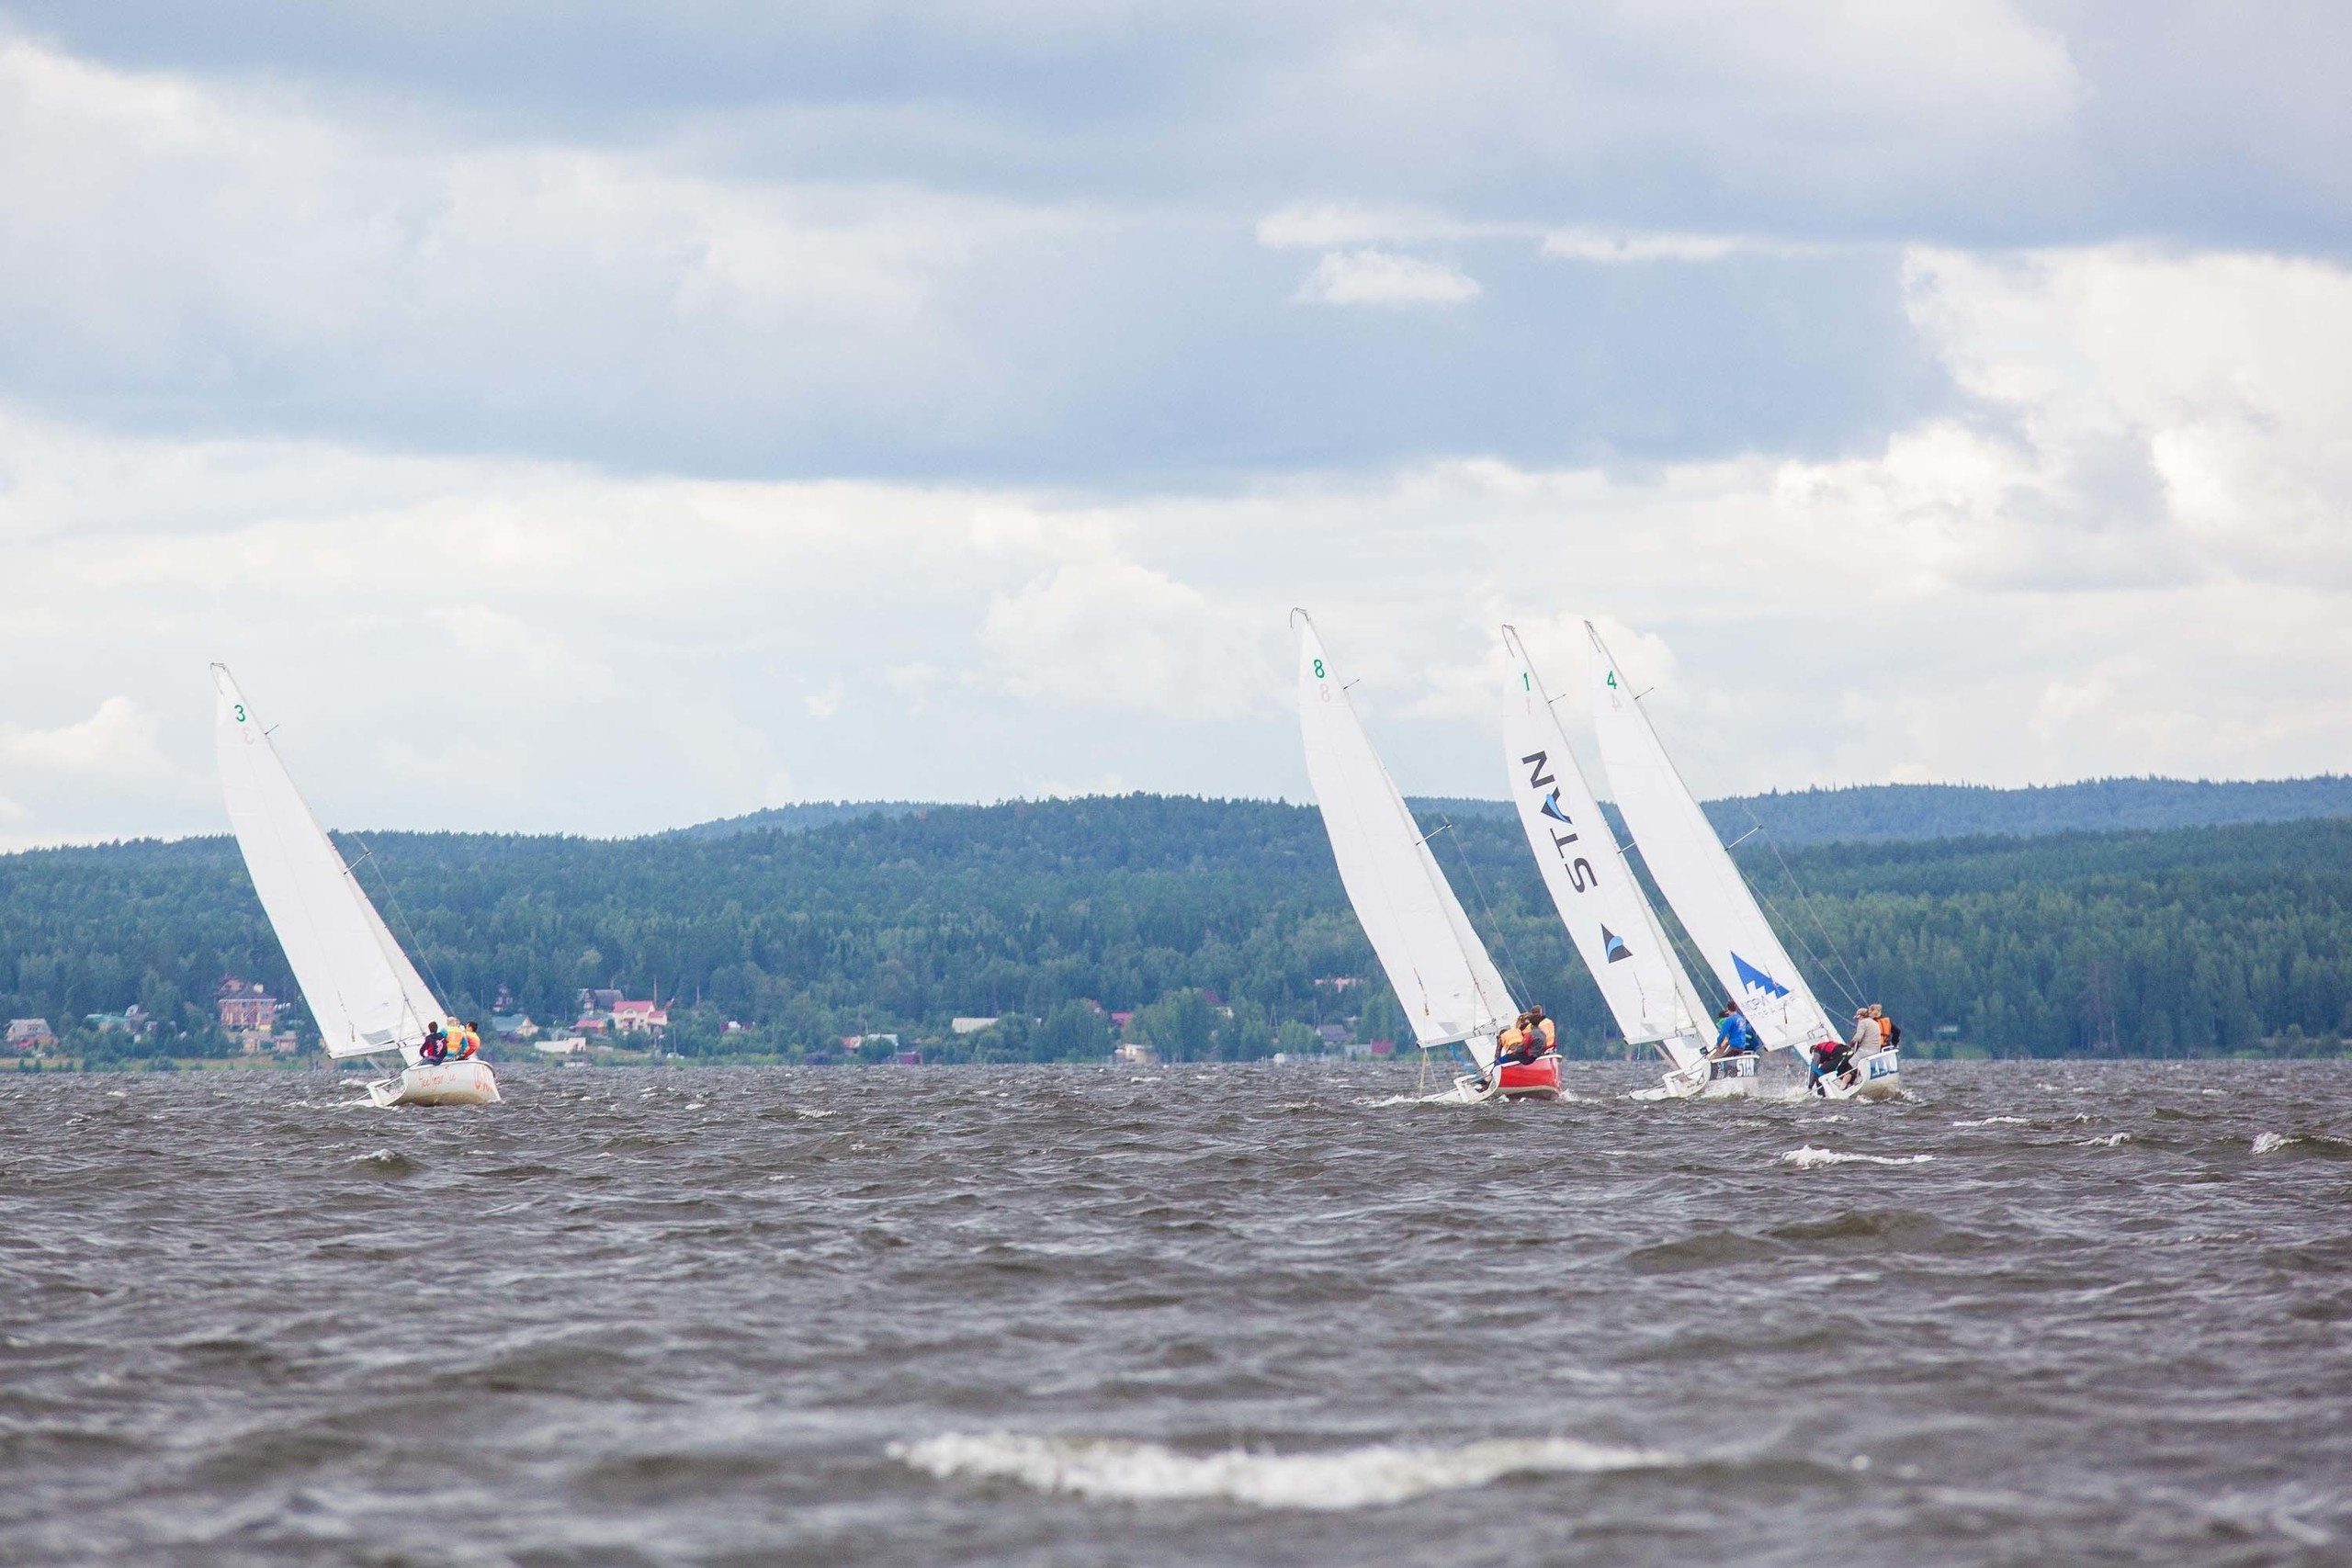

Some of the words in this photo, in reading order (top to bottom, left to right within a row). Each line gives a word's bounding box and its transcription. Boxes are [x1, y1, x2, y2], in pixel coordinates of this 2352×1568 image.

[1313, 659, 1325, 678] 8
[1522, 671, 1531, 692] 1
[1607, 671, 1617, 690] 4
[233, 704, 246, 722] 3
[1521, 750, 1599, 894] STAN
